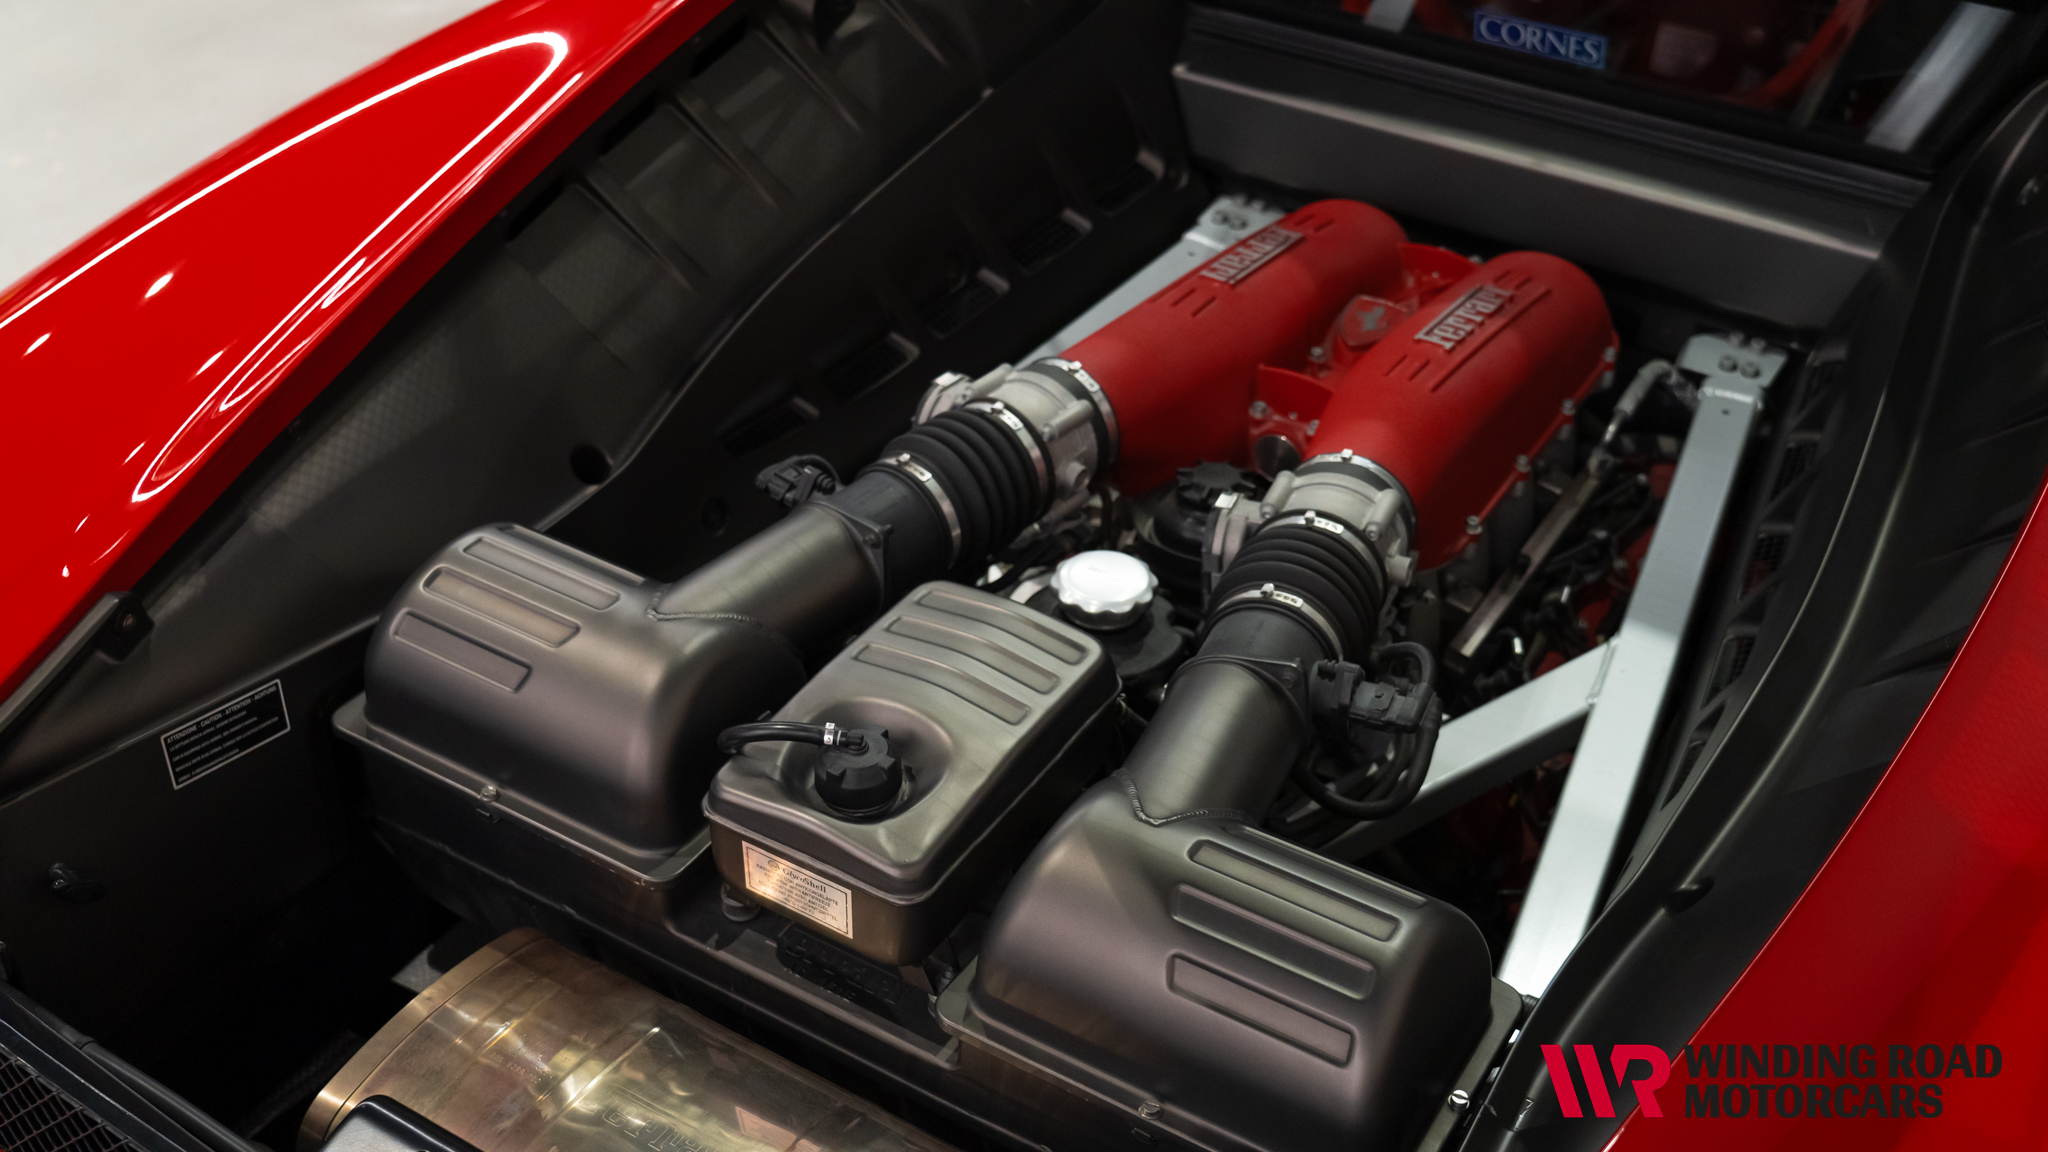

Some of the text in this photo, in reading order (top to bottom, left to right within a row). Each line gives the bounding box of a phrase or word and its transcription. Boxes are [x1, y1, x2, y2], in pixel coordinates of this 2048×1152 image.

[1479, 16, 1600, 64] CORNES
[1414, 284, 1513, 350] Ferrari
[167, 725, 197, 743] ATTENZIONE
[200, 713, 222, 727] CAUTION
[225, 698, 251, 715] ATTENTION
[254, 685, 276, 700] ACHTUNG
[783, 869, 826, 893] GlycoShell
